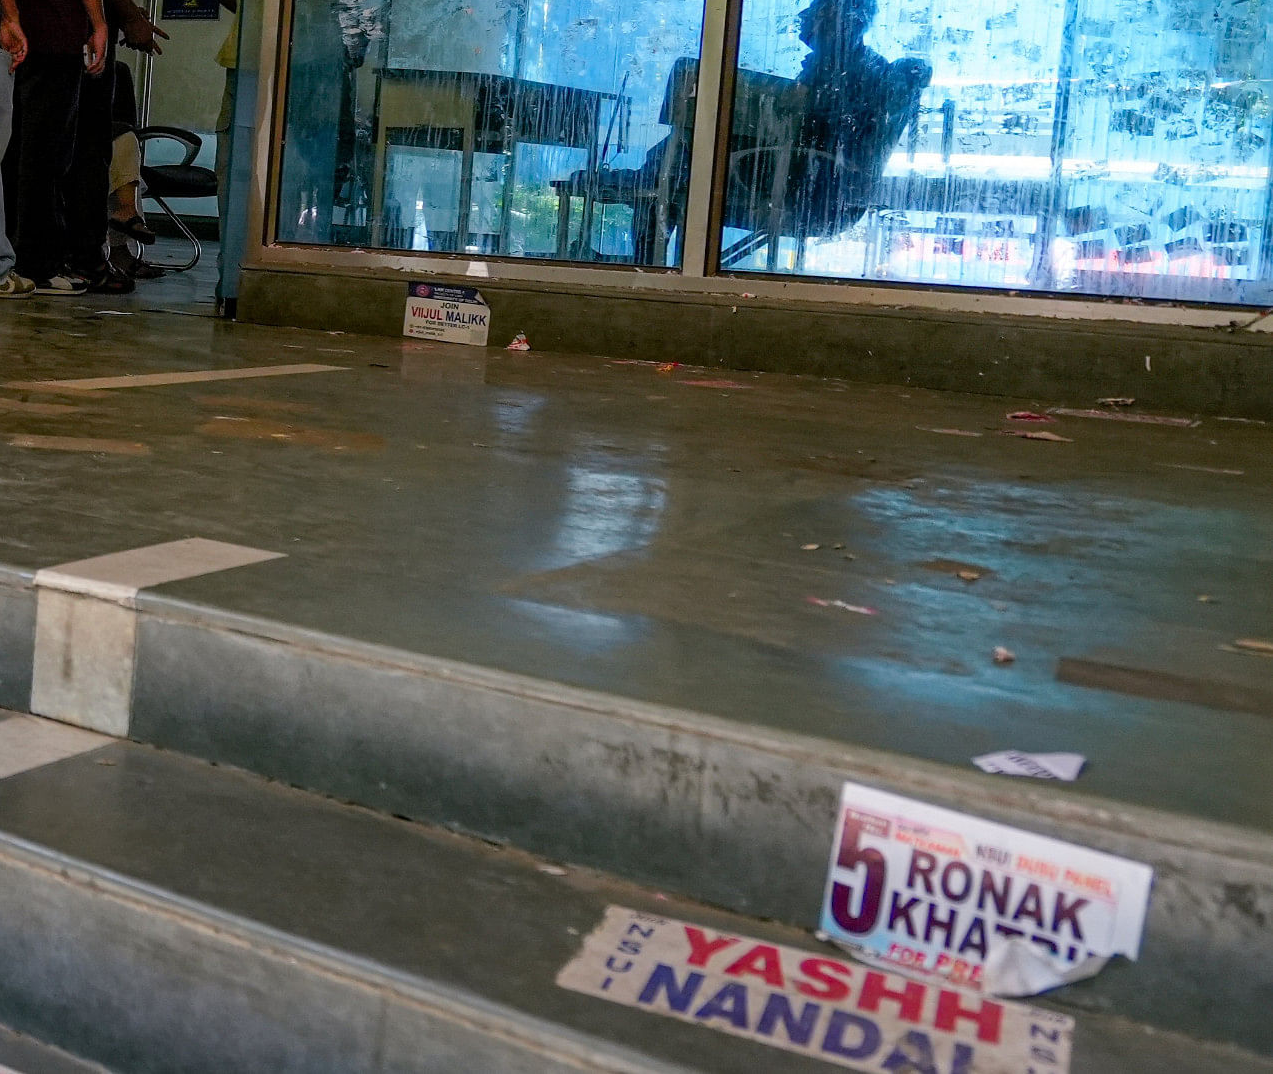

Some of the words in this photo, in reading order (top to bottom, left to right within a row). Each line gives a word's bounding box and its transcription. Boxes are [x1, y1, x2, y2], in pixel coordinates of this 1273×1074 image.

[411, 306, 443, 321] VIIJUL
[445, 310, 487, 327] MALIKK
[440, 302, 459, 310] JOIN
[831, 808, 892, 935] 5
[907, 848, 1092, 942] RONAK
[602, 923, 655, 991] NSUI
[682, 925, 1004, 1046] YASHH
[888, 942, 928, 966] FOR
